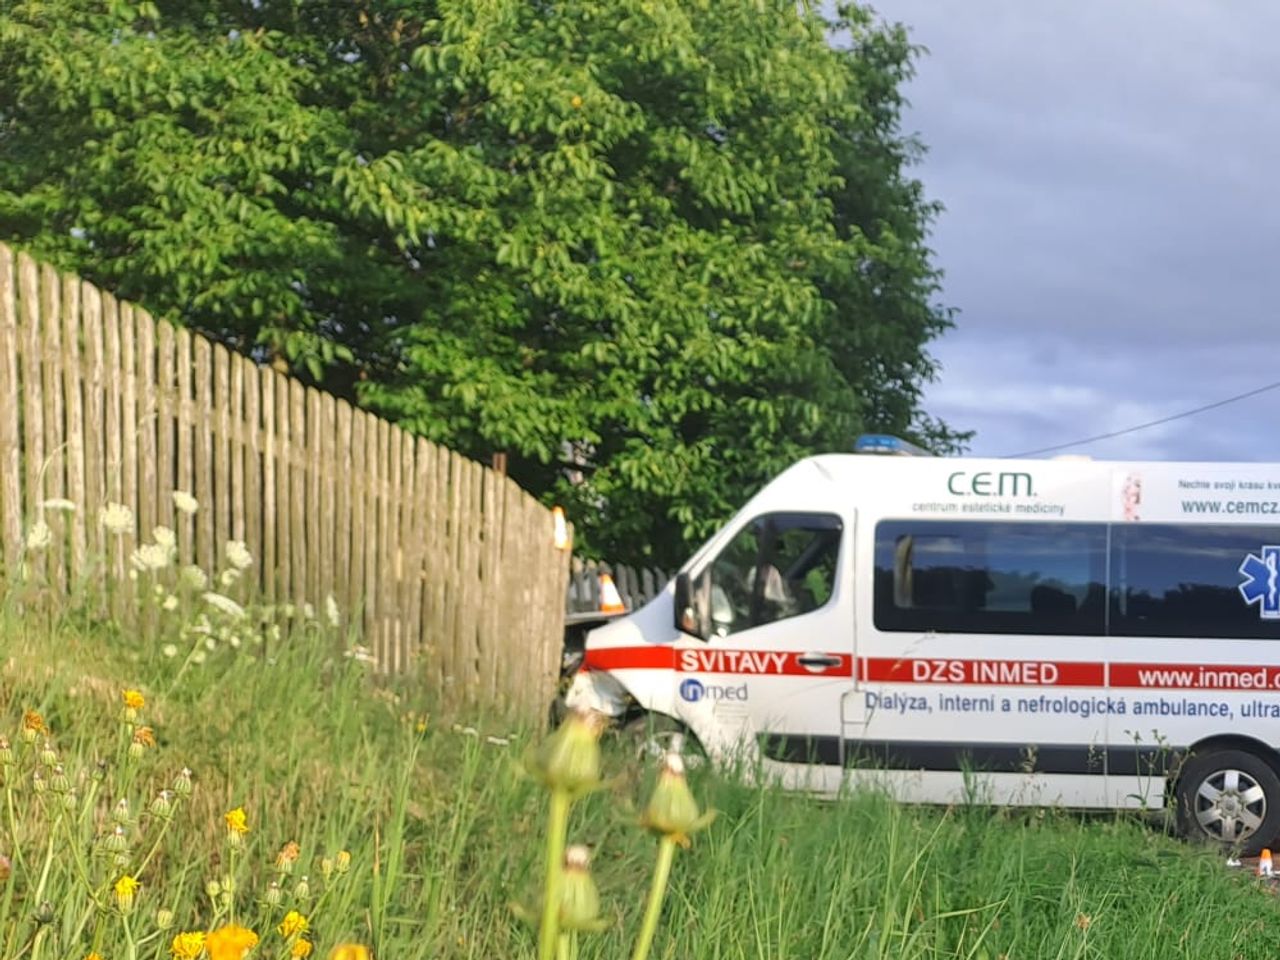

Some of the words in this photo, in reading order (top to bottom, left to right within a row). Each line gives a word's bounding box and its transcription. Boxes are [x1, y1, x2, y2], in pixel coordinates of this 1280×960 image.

[912, 502, 958, 514] centrum
[680, 649, 788, 674] SVITAVY
[912, 659, 966, 682] DZS
[972, 662, 1059, 684] INMED
[1001, 698, 1011, 712] a
[1132, 697, 1234, 721] ambulance,
